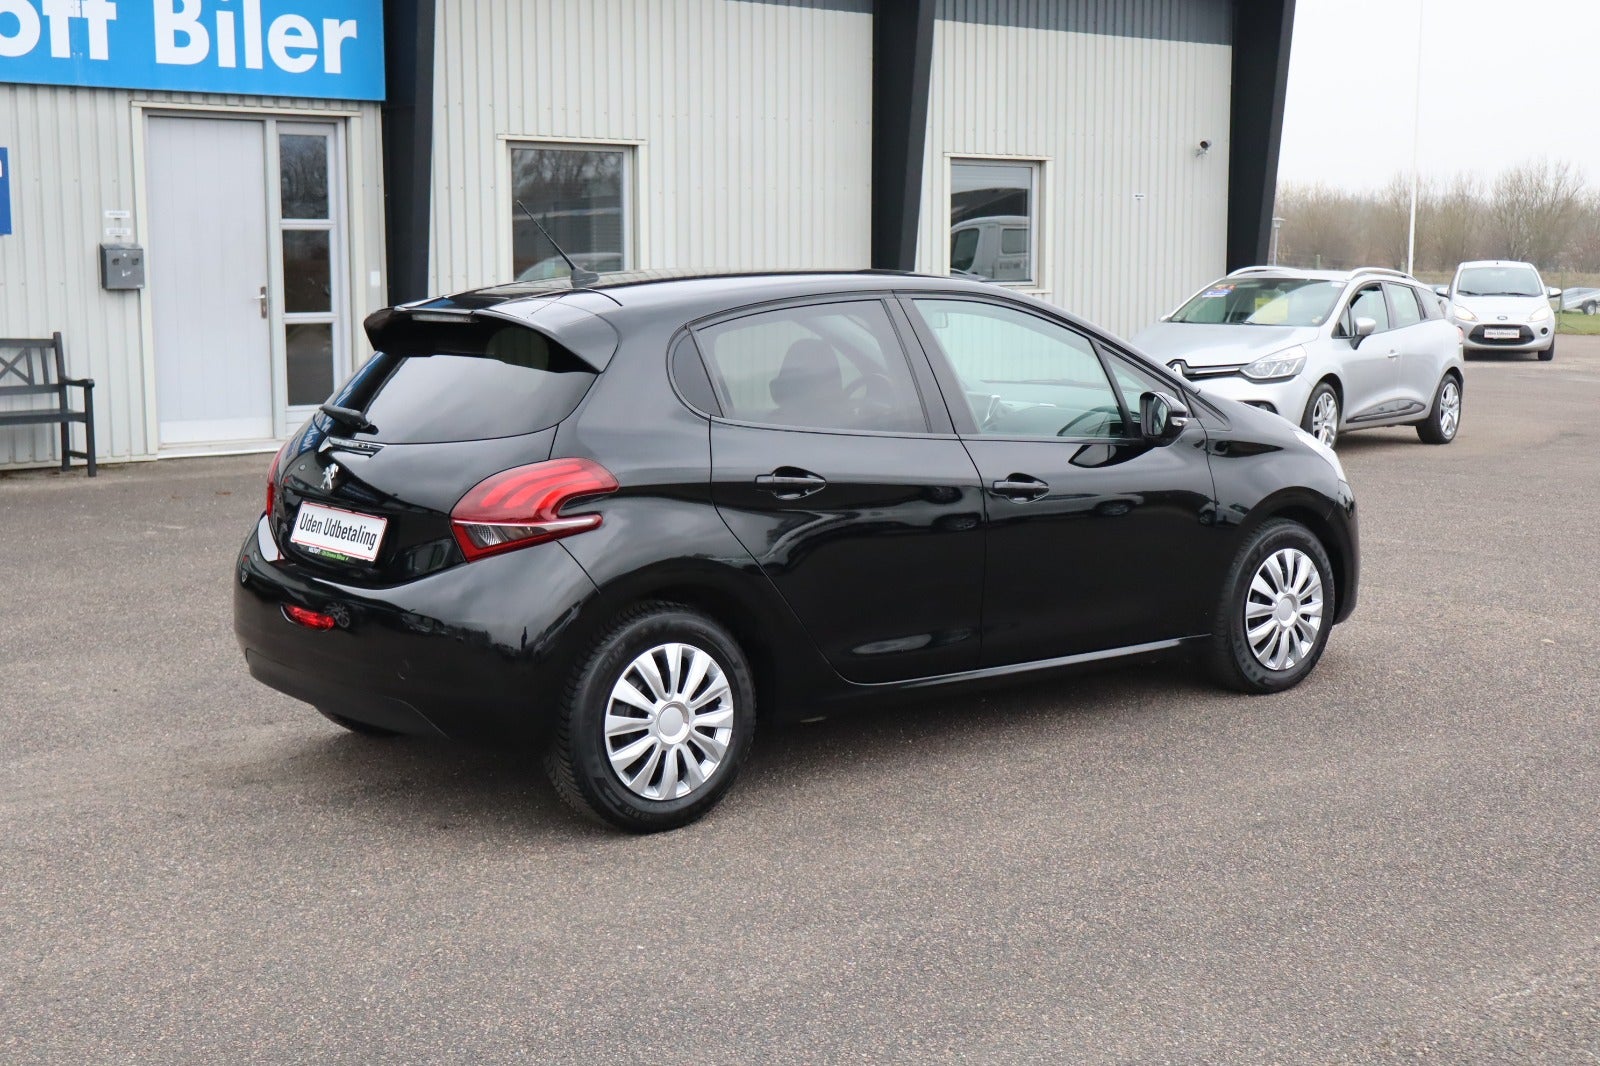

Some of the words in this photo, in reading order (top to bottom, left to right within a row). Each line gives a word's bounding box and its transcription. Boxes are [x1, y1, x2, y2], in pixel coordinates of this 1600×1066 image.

[153, 0, 357, 74] Biler
[300, 512, 322, 534] Uden
[323, 517, 378, 551] Udbetaling
